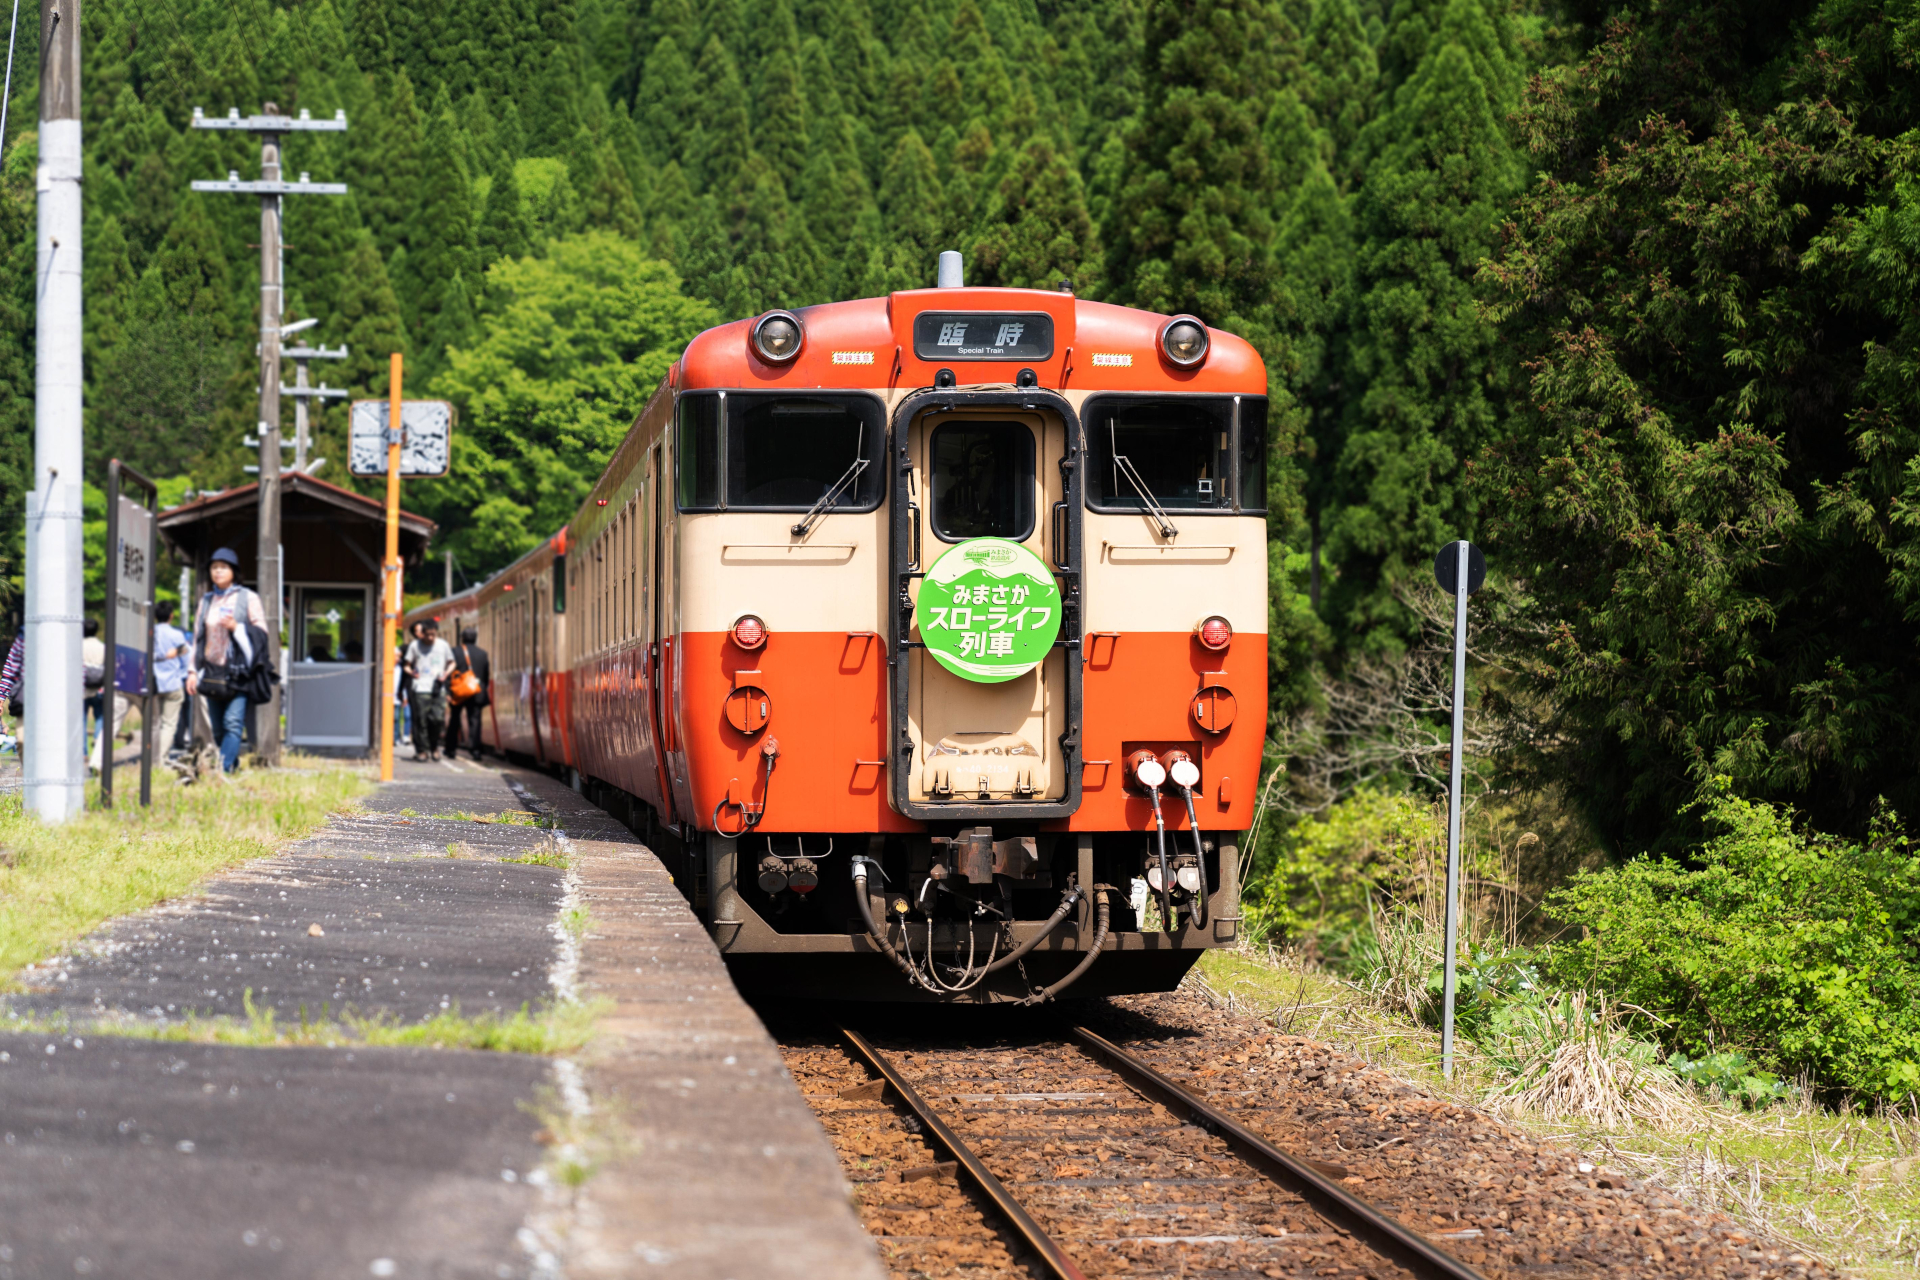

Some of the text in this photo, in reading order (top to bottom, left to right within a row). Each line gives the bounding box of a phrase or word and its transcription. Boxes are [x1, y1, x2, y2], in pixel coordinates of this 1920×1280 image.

[937, 322, 1025, 346] 臨時
[957, 347, 984, 355] Special
[952, 584, 1030, 605] みまさか
[926, 606, 1051, 631] スローライフ
[957, 630, 1015, 658] 列車
[986, 764, 1009, 774] 2134
